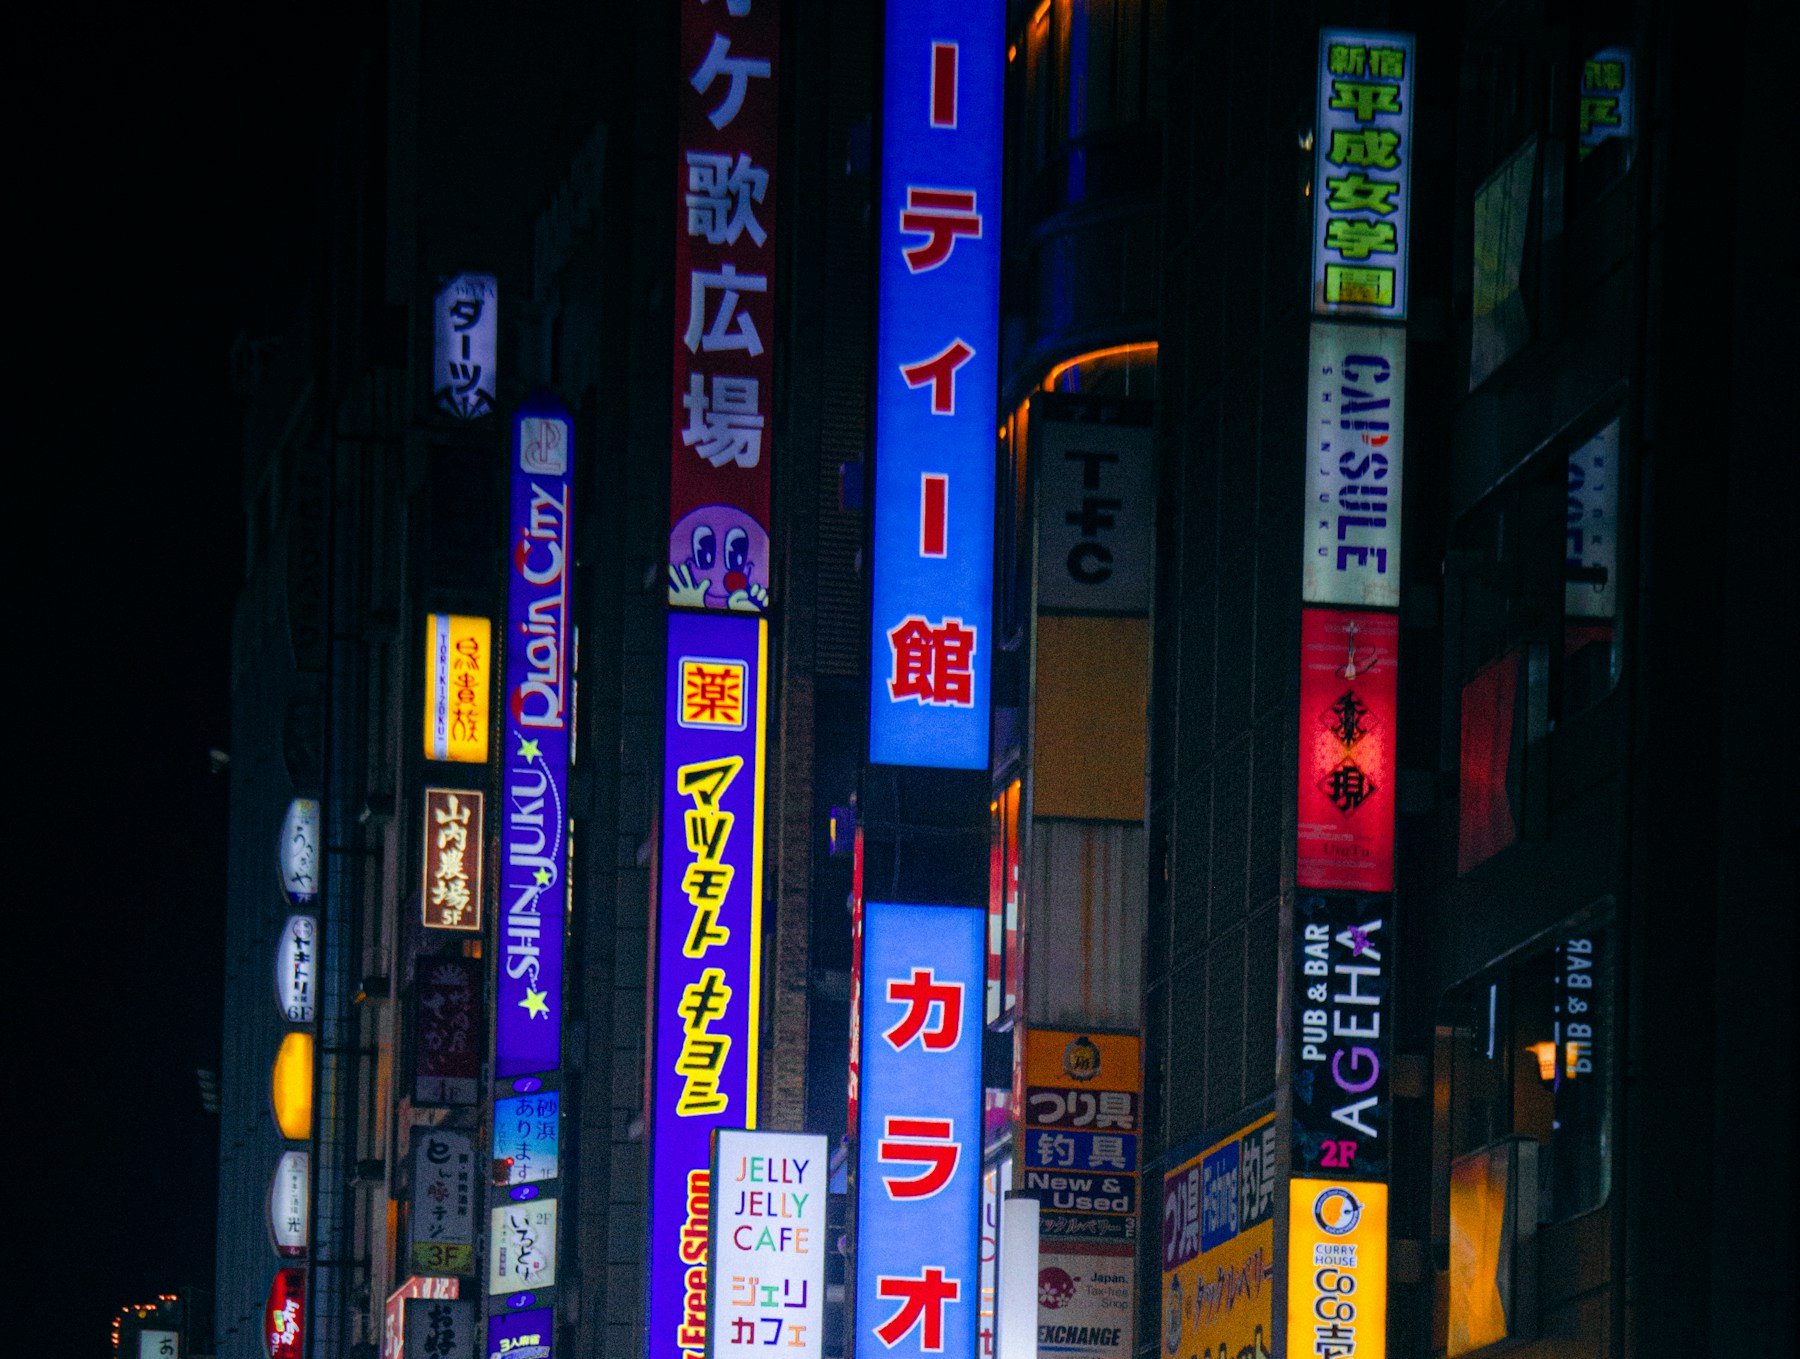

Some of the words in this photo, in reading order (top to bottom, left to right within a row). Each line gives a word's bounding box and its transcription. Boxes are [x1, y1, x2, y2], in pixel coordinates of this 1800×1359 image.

[1328, 44, 1406, 81] 新宿
[448, 300, 484, 395] ダーツ
[1318, 366, 1333, 558] SHINJUKU
[1336, 352, 1392, 575] CAPSULE
[686, 666, 741, 722] 薬
[506, 767, 559, 981] SHINJUKU
[677, 755, 745, 1118] マツモトキヨシ
[1303, 921, 1331, 976] BAR
[1307, 983, 1328, 1003] &
[1302, 1007, 1329, 1063] PUB
[1331, 919, 1383, 1139] AGEHA
[1029, 1091, 1135, 1131] つり具
[735, 1156, 811, 1184] JELLY
[1320, 1140, 1358, 1169] 2F
[1028, 1172, 1093, 1193] New
[1101, 1178, 1122, 1194] &
[1203, 1157, 1239, 1236] Fishing
[734, 1192, 810, 1220] JELLY
[1053, 1190, 1129, 1213] Used
[1165, 1169, 1200, 1263] つり具
[536, 1212, 552, 1226] 2F
[426, 1244, 460, 1267] 3F
[733, 1223, 811, 1255] CAFE
[1315, 1244, 1356, 1256] CURRY
[1314, 1256, 1357, 1267] HOUSE
[731, 1275, 808, 1309] ジェリ
[731, 1316, 808, 1348] カフェ
[1038, 1325, 1121, 1346] EXCHANGE
